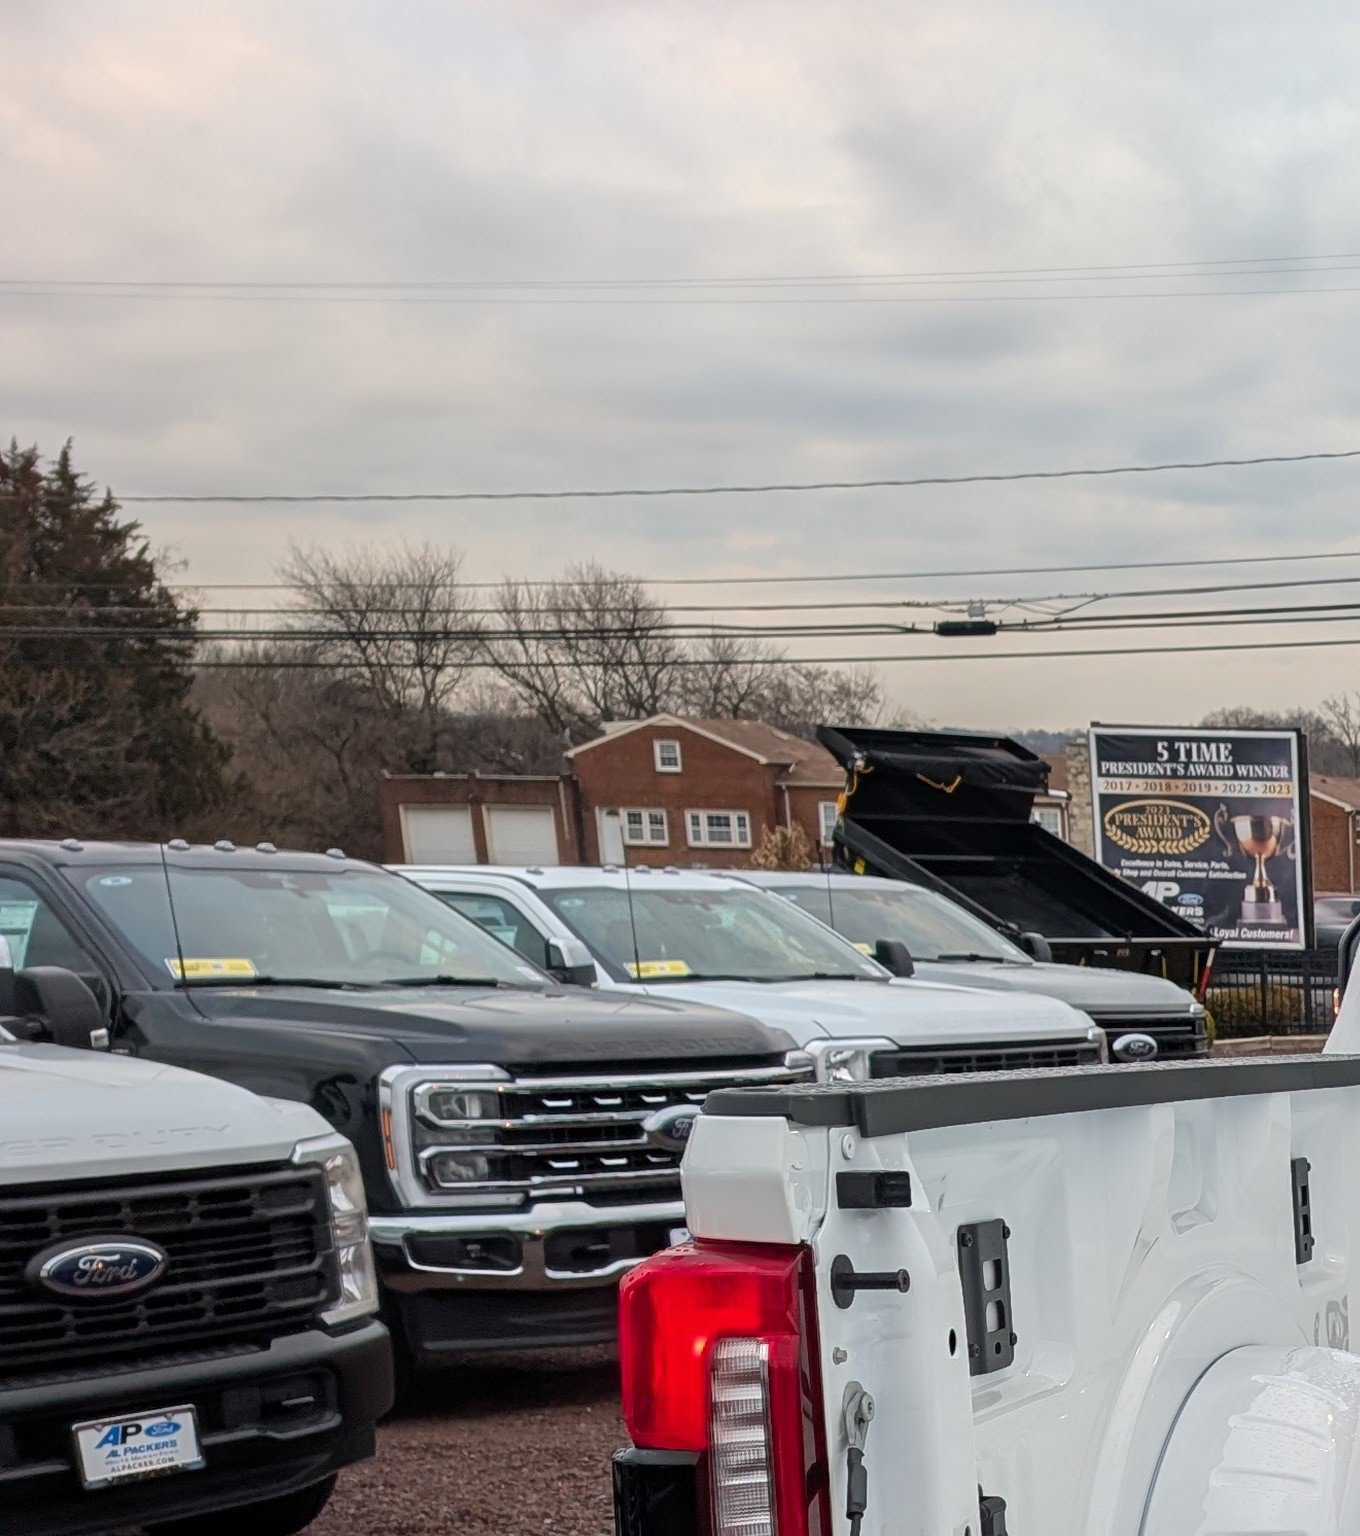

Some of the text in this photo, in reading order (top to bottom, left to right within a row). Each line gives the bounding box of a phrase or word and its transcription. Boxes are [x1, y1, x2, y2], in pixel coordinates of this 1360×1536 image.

[1156, 741, 1233, 763] 5 TIME
[1101, 761, 1289, 779] PRESIDENT'S AWARD WINNER
[1103, 780, 1291, 796] 2017 2018 2019 2022 2023
[1114, 812, 1202, 828] PRESIDENT'S
[1136, 827, 1182, 839] AWARD
[1213, 927, 1239, 939] Loyal
[73, 1253, 138, 1285] Ford
[94, 1423, 143, 1450] AP
